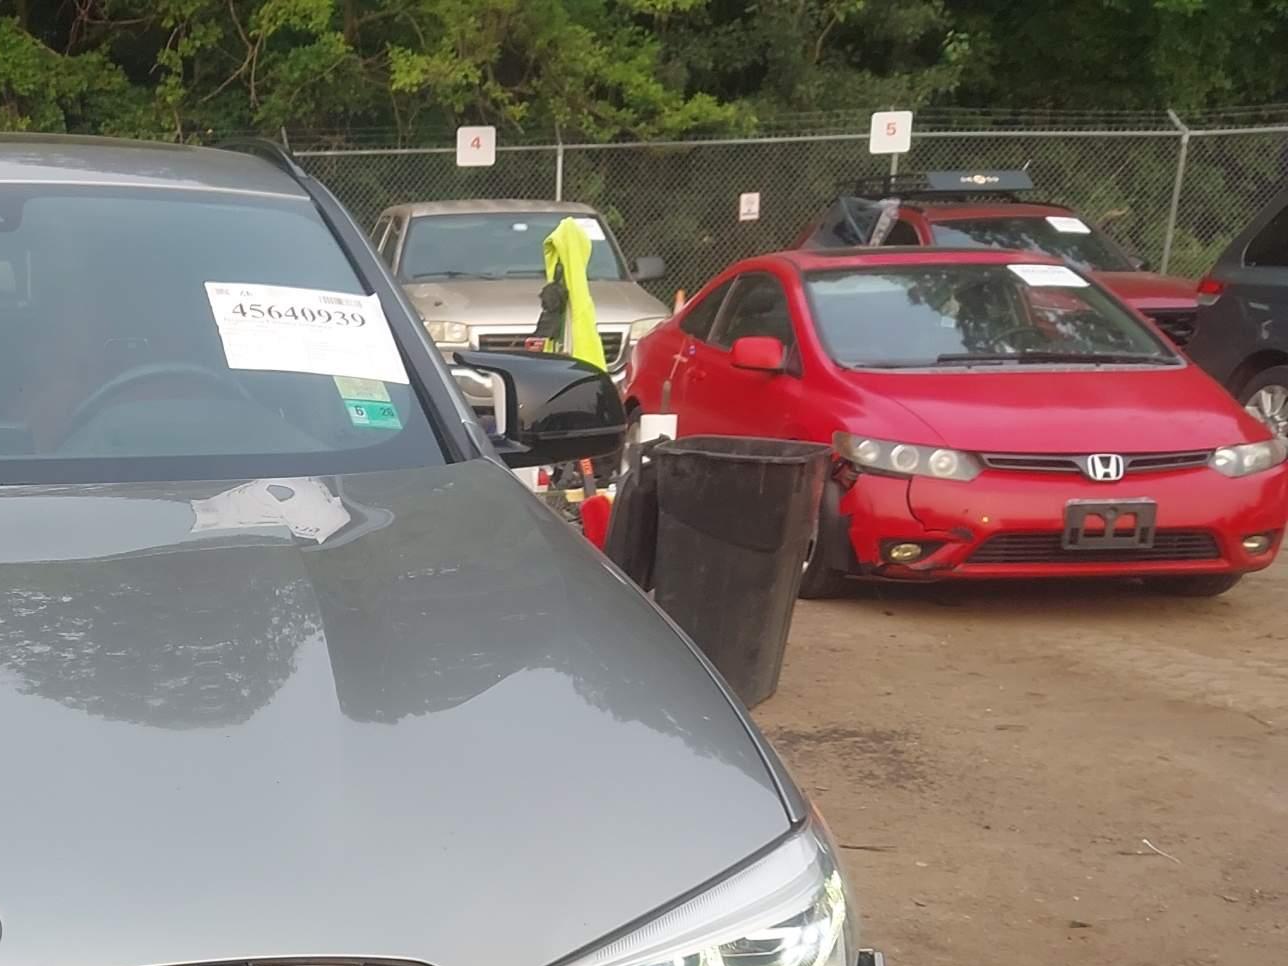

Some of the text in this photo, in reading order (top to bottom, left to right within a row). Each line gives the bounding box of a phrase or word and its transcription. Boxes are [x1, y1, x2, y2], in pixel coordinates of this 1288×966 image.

[886, 121, 897, 137] 5
[470, 136, 481, 150] 4
[231, 302, 366, 328] 45640939
[354, 405, 364, 417] 6
